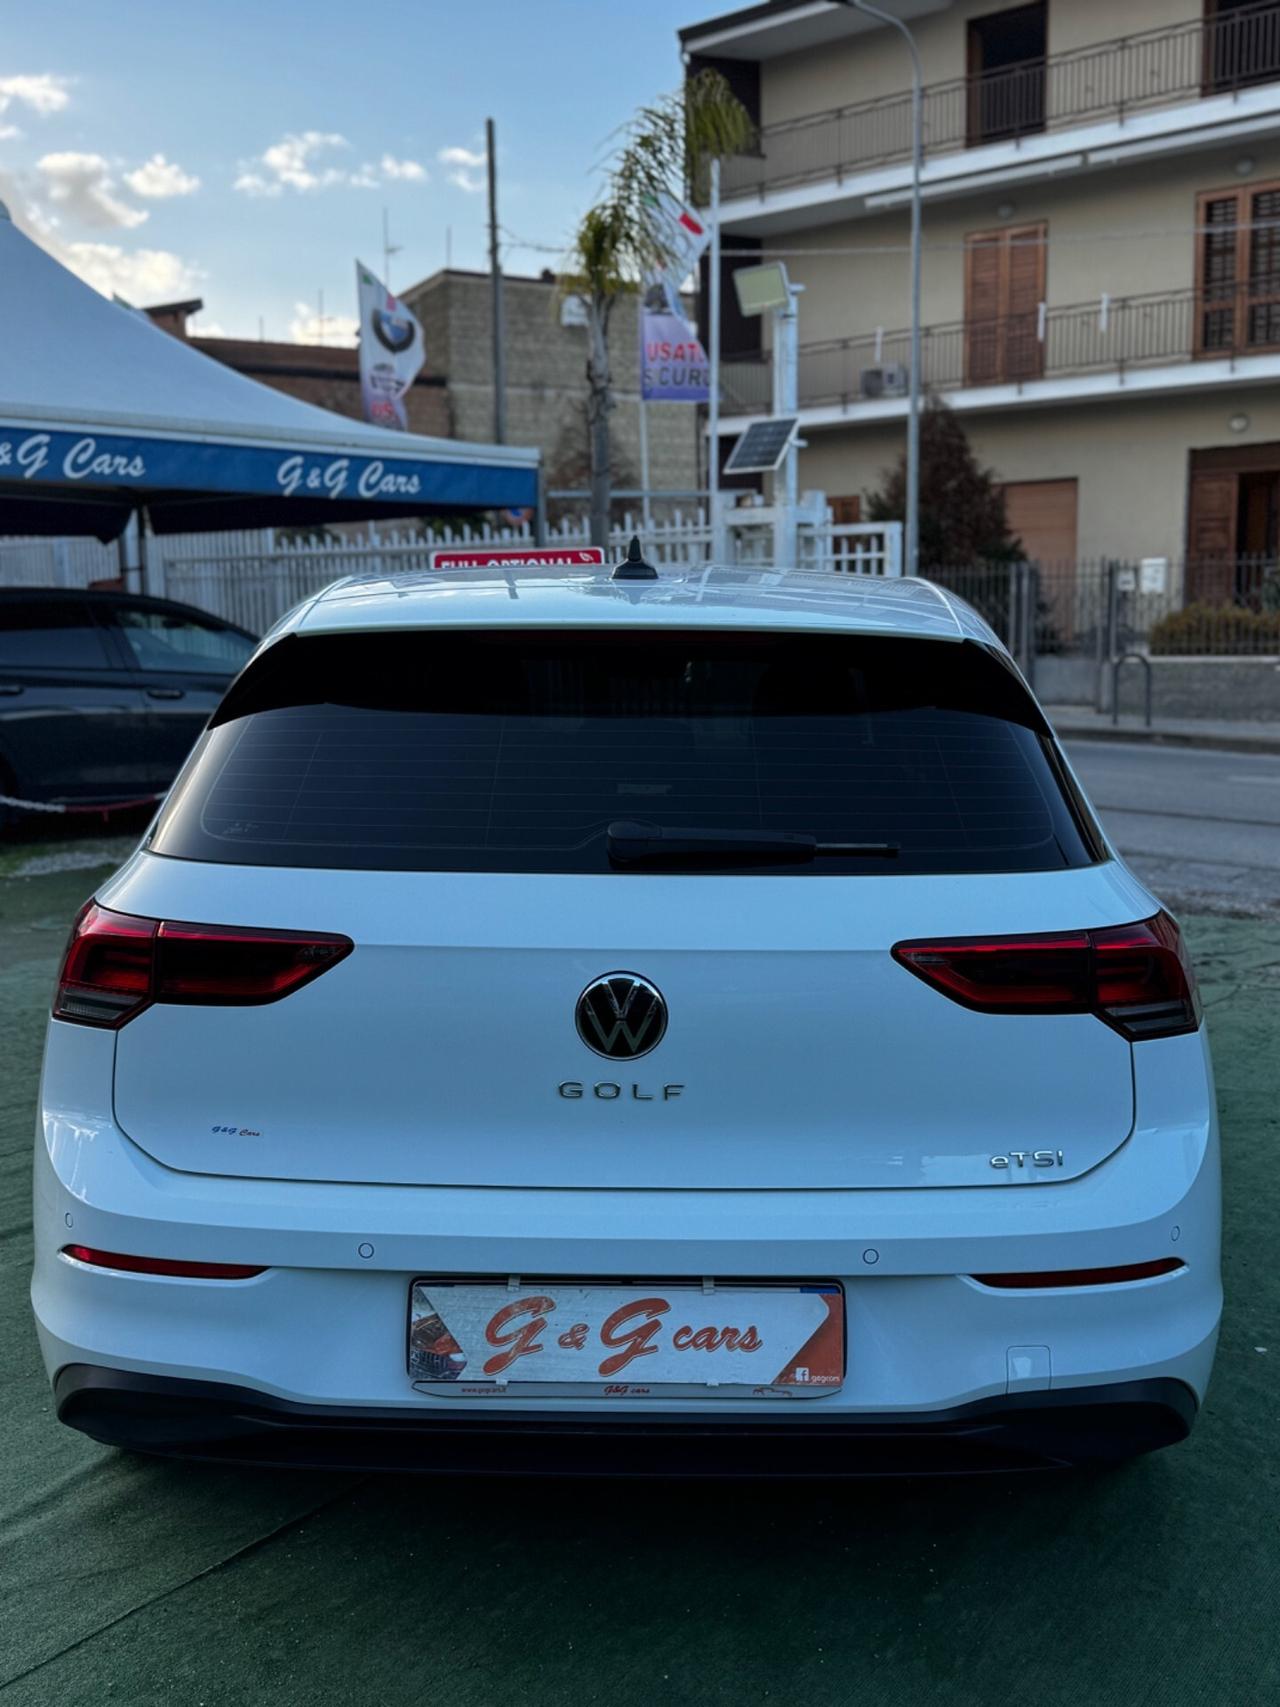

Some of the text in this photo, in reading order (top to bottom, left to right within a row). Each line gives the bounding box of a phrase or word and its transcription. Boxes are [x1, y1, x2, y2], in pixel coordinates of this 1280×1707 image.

[63, 438, 146, 479] Cars
[358, 461, 421, 498] Cars
[558, 1081, 685, 1101] GOLF
[672, 1324, 763, 1353] cars
